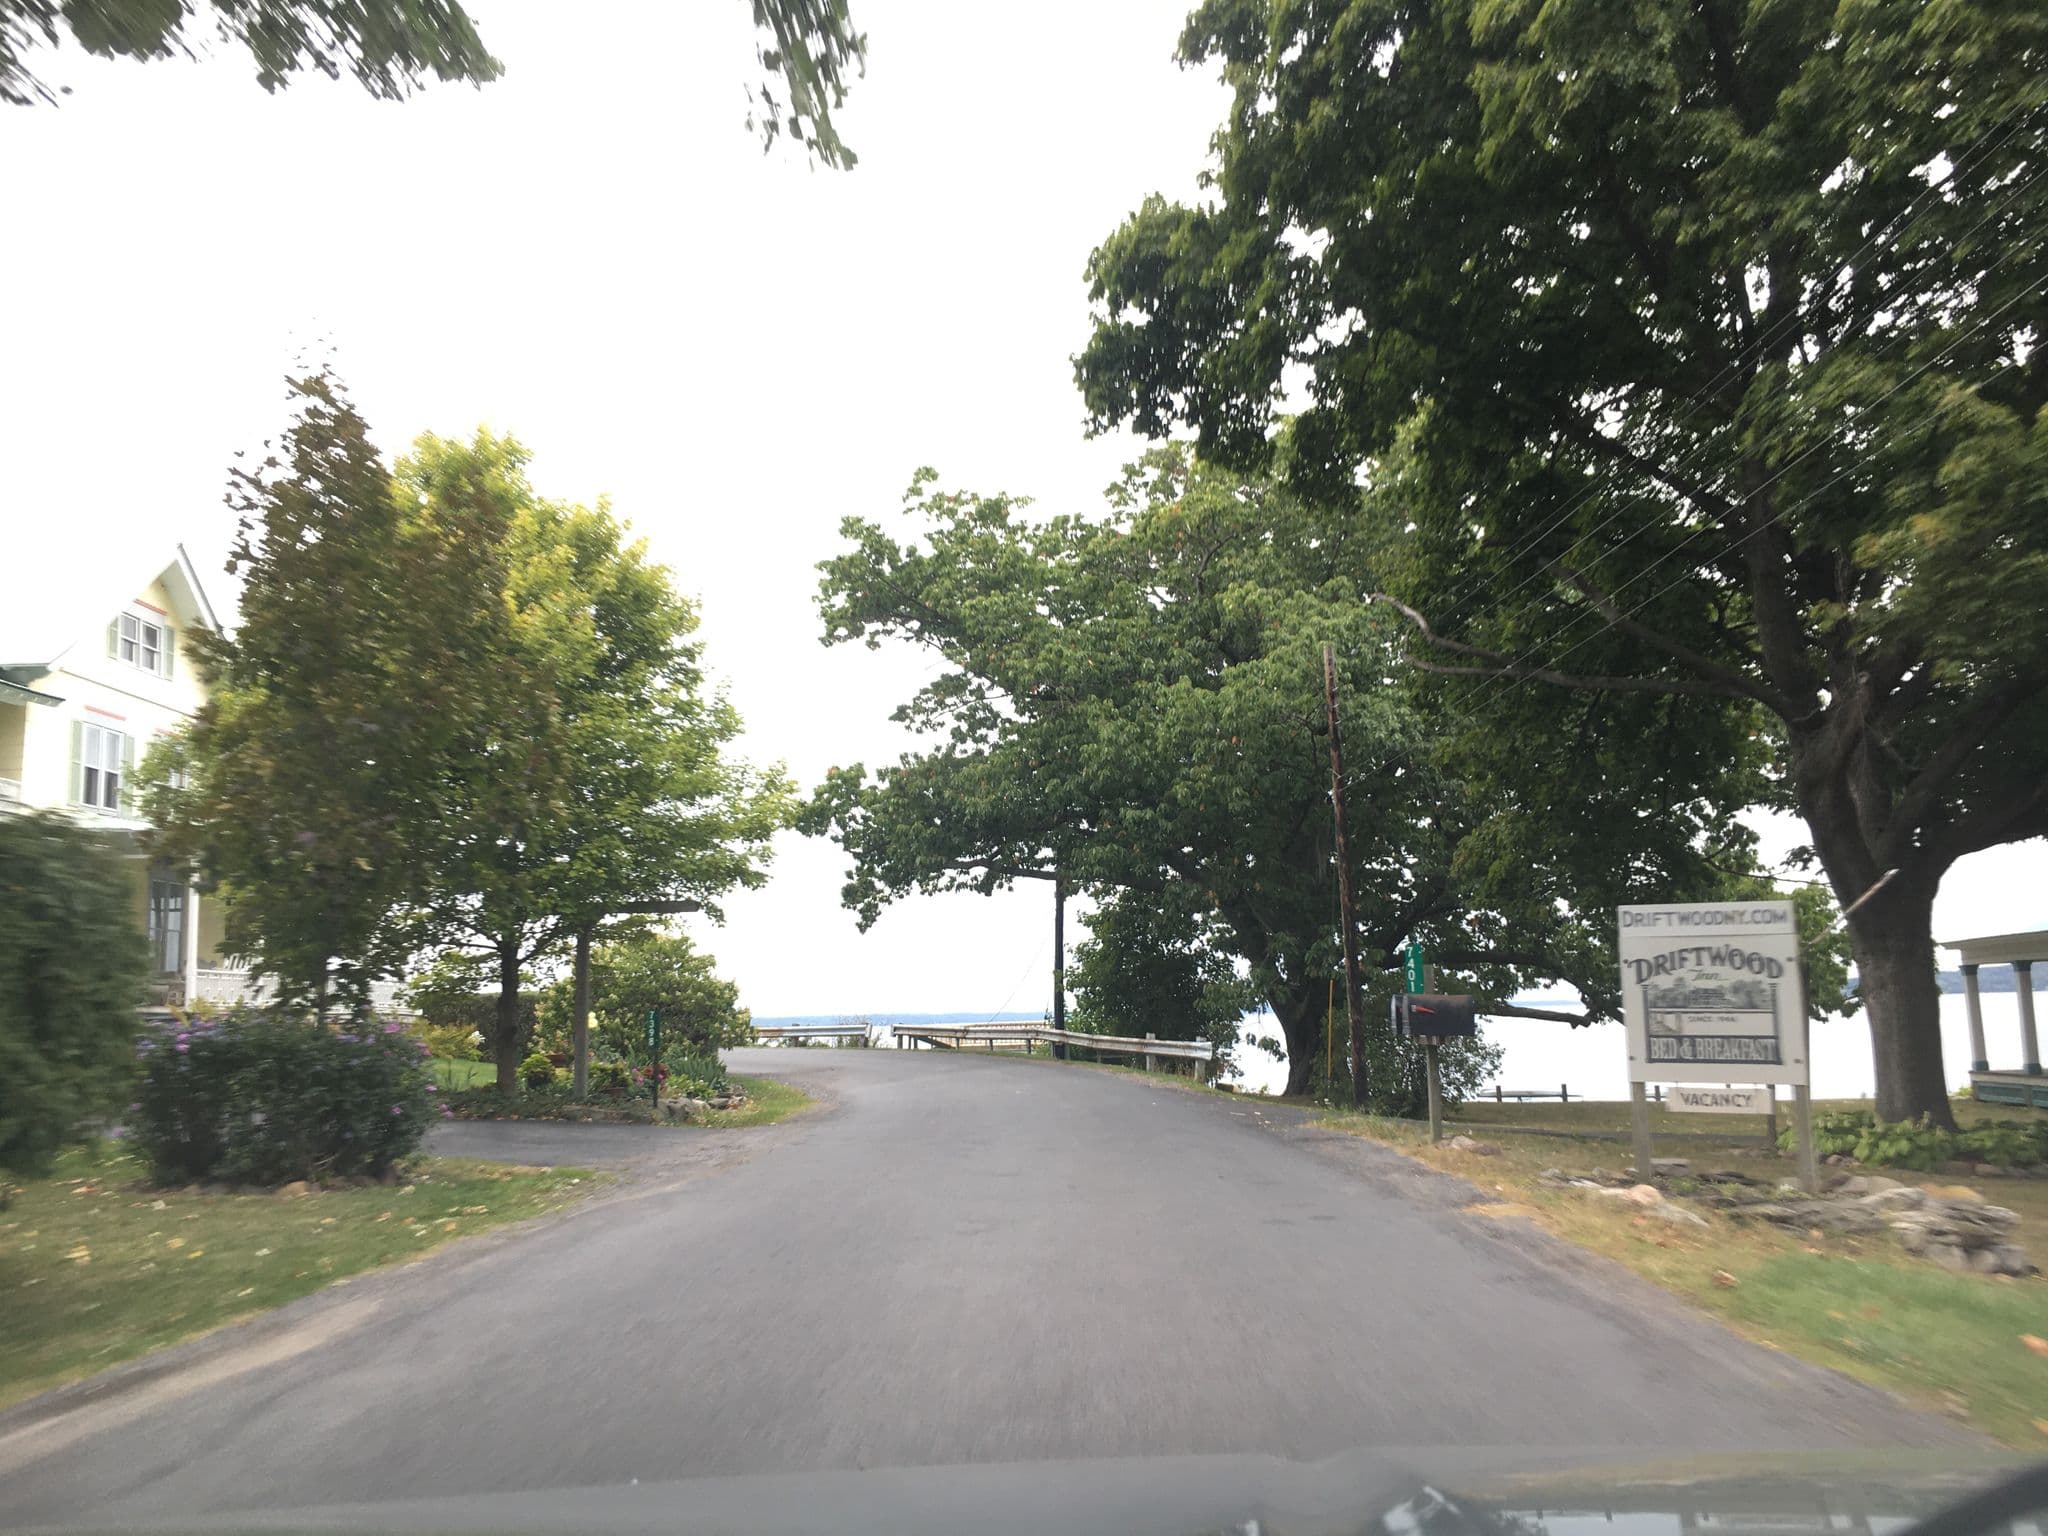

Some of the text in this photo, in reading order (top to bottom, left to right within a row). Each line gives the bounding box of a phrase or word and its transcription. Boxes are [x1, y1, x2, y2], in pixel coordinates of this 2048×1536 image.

[1622, 910, 1786, 928] DRIFTWOODNY.COM
[1406, 947, 1415, 993] 7401
[1628, 944, 1784, 985] DRIFTWOOD
[1650, 1038, 1776, 1061] BED & BREAKFAST
[1680, 1093, 1752, 1107] VACANCY
